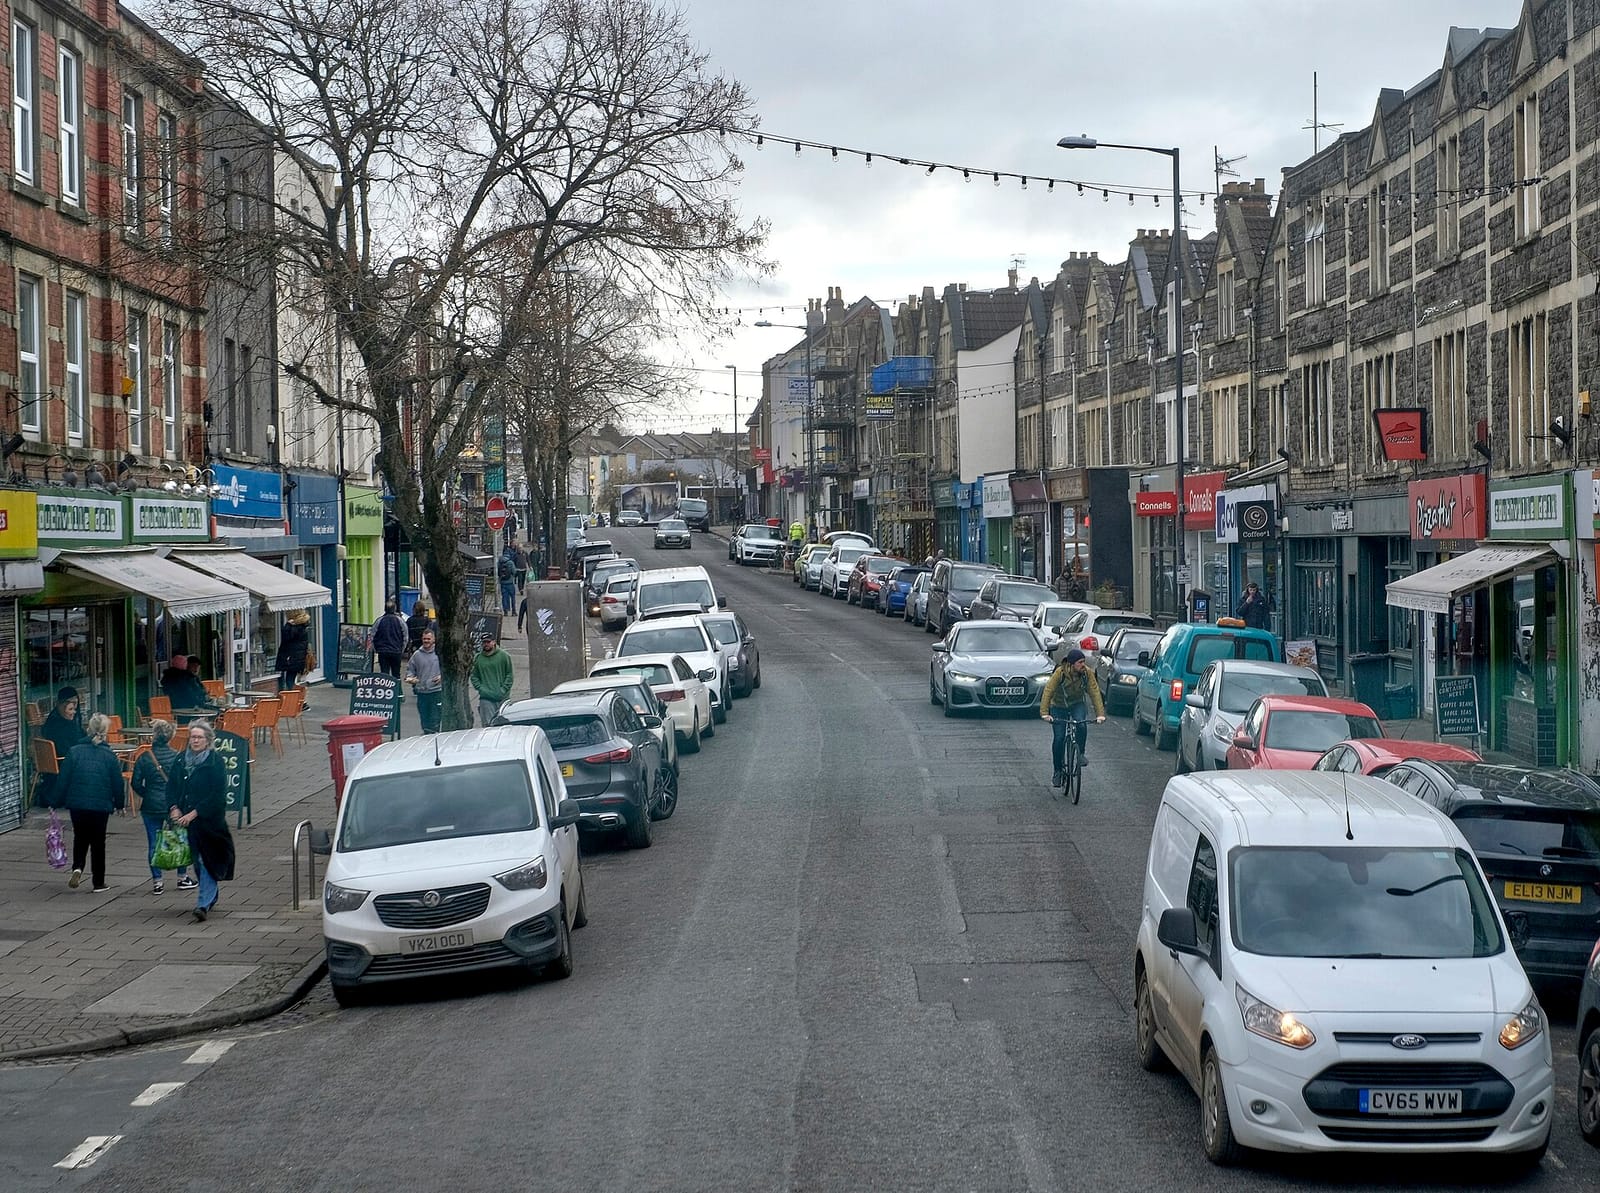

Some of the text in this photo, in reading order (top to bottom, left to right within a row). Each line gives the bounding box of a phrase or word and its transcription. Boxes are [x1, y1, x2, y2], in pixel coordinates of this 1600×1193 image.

[1140, 501, 1172, 510] Connells
[1189, 489, 1212, 513] Connells
[1539, 494, 1558, 519] deli
[1416, 489, 1456, 540] Pizza Hut
[356, 677, 396, 688] HOT SOUP
[356, 687, 394, 699] £3.99
[353, 709, 393, 719] SANDWICH
[214, 738, 237, 752] CAL
[1513, 884, 1573, 900] EL13 NJM
[408, 934, 465, 951] VK21 OCD
[1372, 1093, 1458, 1109] CV65 WVW
